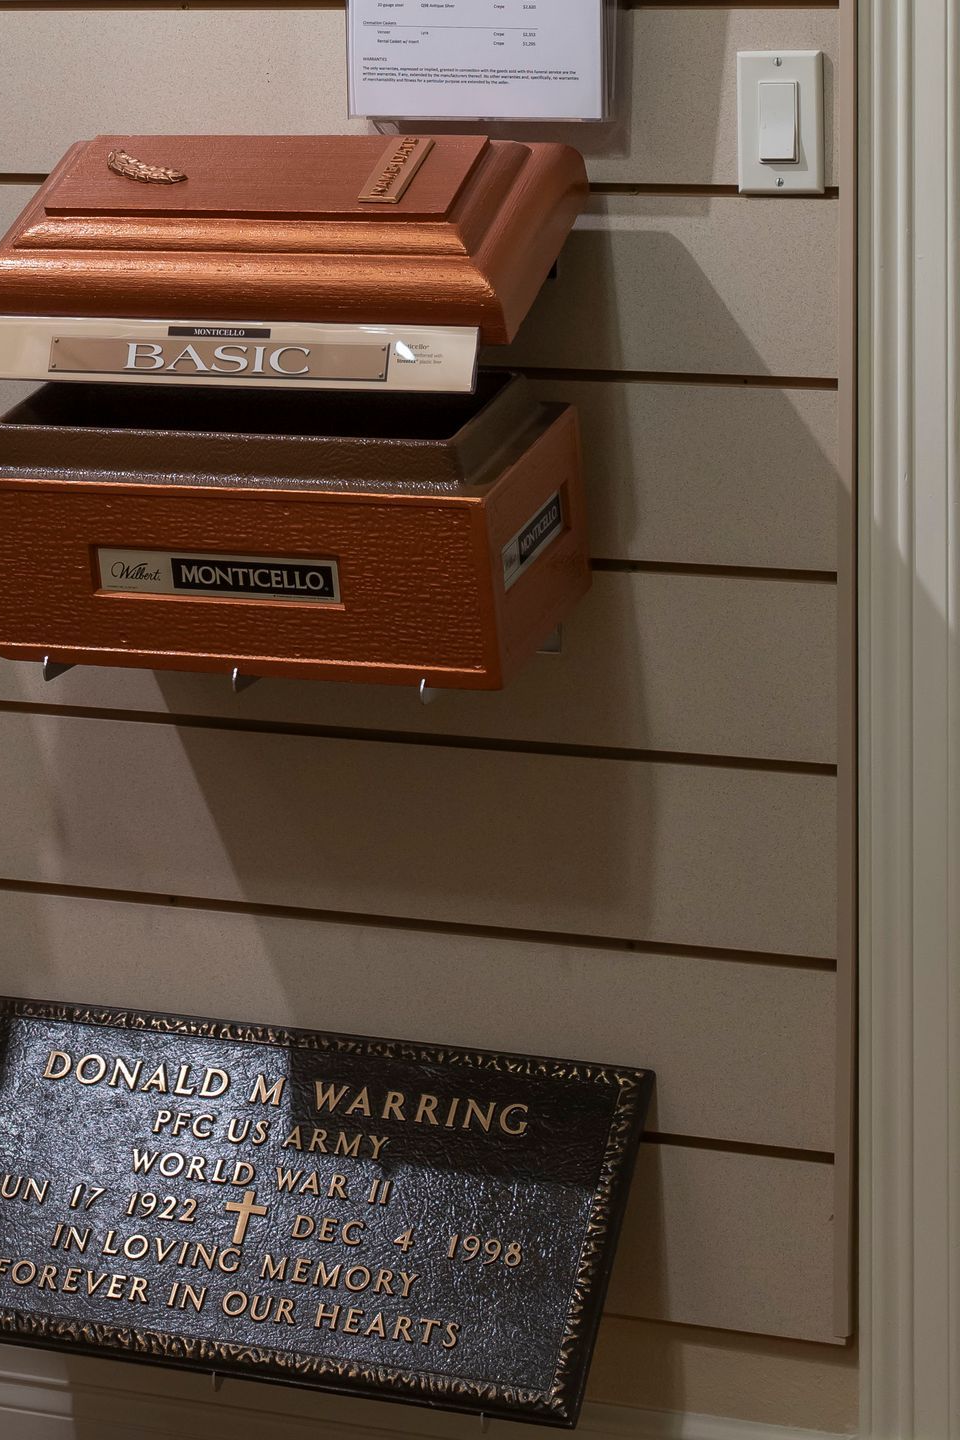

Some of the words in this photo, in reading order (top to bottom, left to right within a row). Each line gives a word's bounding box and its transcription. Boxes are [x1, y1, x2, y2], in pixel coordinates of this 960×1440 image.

[123, 342, 311, 375] BASIC
[193, 329, 245, 337] MONTICELLO
[111, 561, 160, 581] Wilbert
[180, 564, 325, 591] MONTICELLO
[43, 1050, 230, 1098] DONALD
[248, 1073, 287, 1107] M
[313, 1081, 529, 1136] WARRING
[152, 1109, 216, 1140] PFC
[226, 1117, 271, 1145] US
[281, 1124, 391, 1160] ARMY
[132, 1148, 256, 1186] WORLD
[276, 1166, 348, 1200] WAR
[367, 1178, 394, 1205] II
[70, 1183, 106, 1210] 17
[125, 1191, 198, 1224] 1922
[291, 1214, 366, 1246] DEC
[393, 1227, 415, 1253] 4
[447, 1233, 523, 1268] 1998
[51, 1222, 92, 1253] IN
[102, 1230, 241, 1273] LOVING
[259, 1253, 420, 1298] MEMORY
[167, 1282, 207, 1312] IN
[221, 1290, 296, 1325] OUR
[313, 1303, 461, 1349] HEARTS
